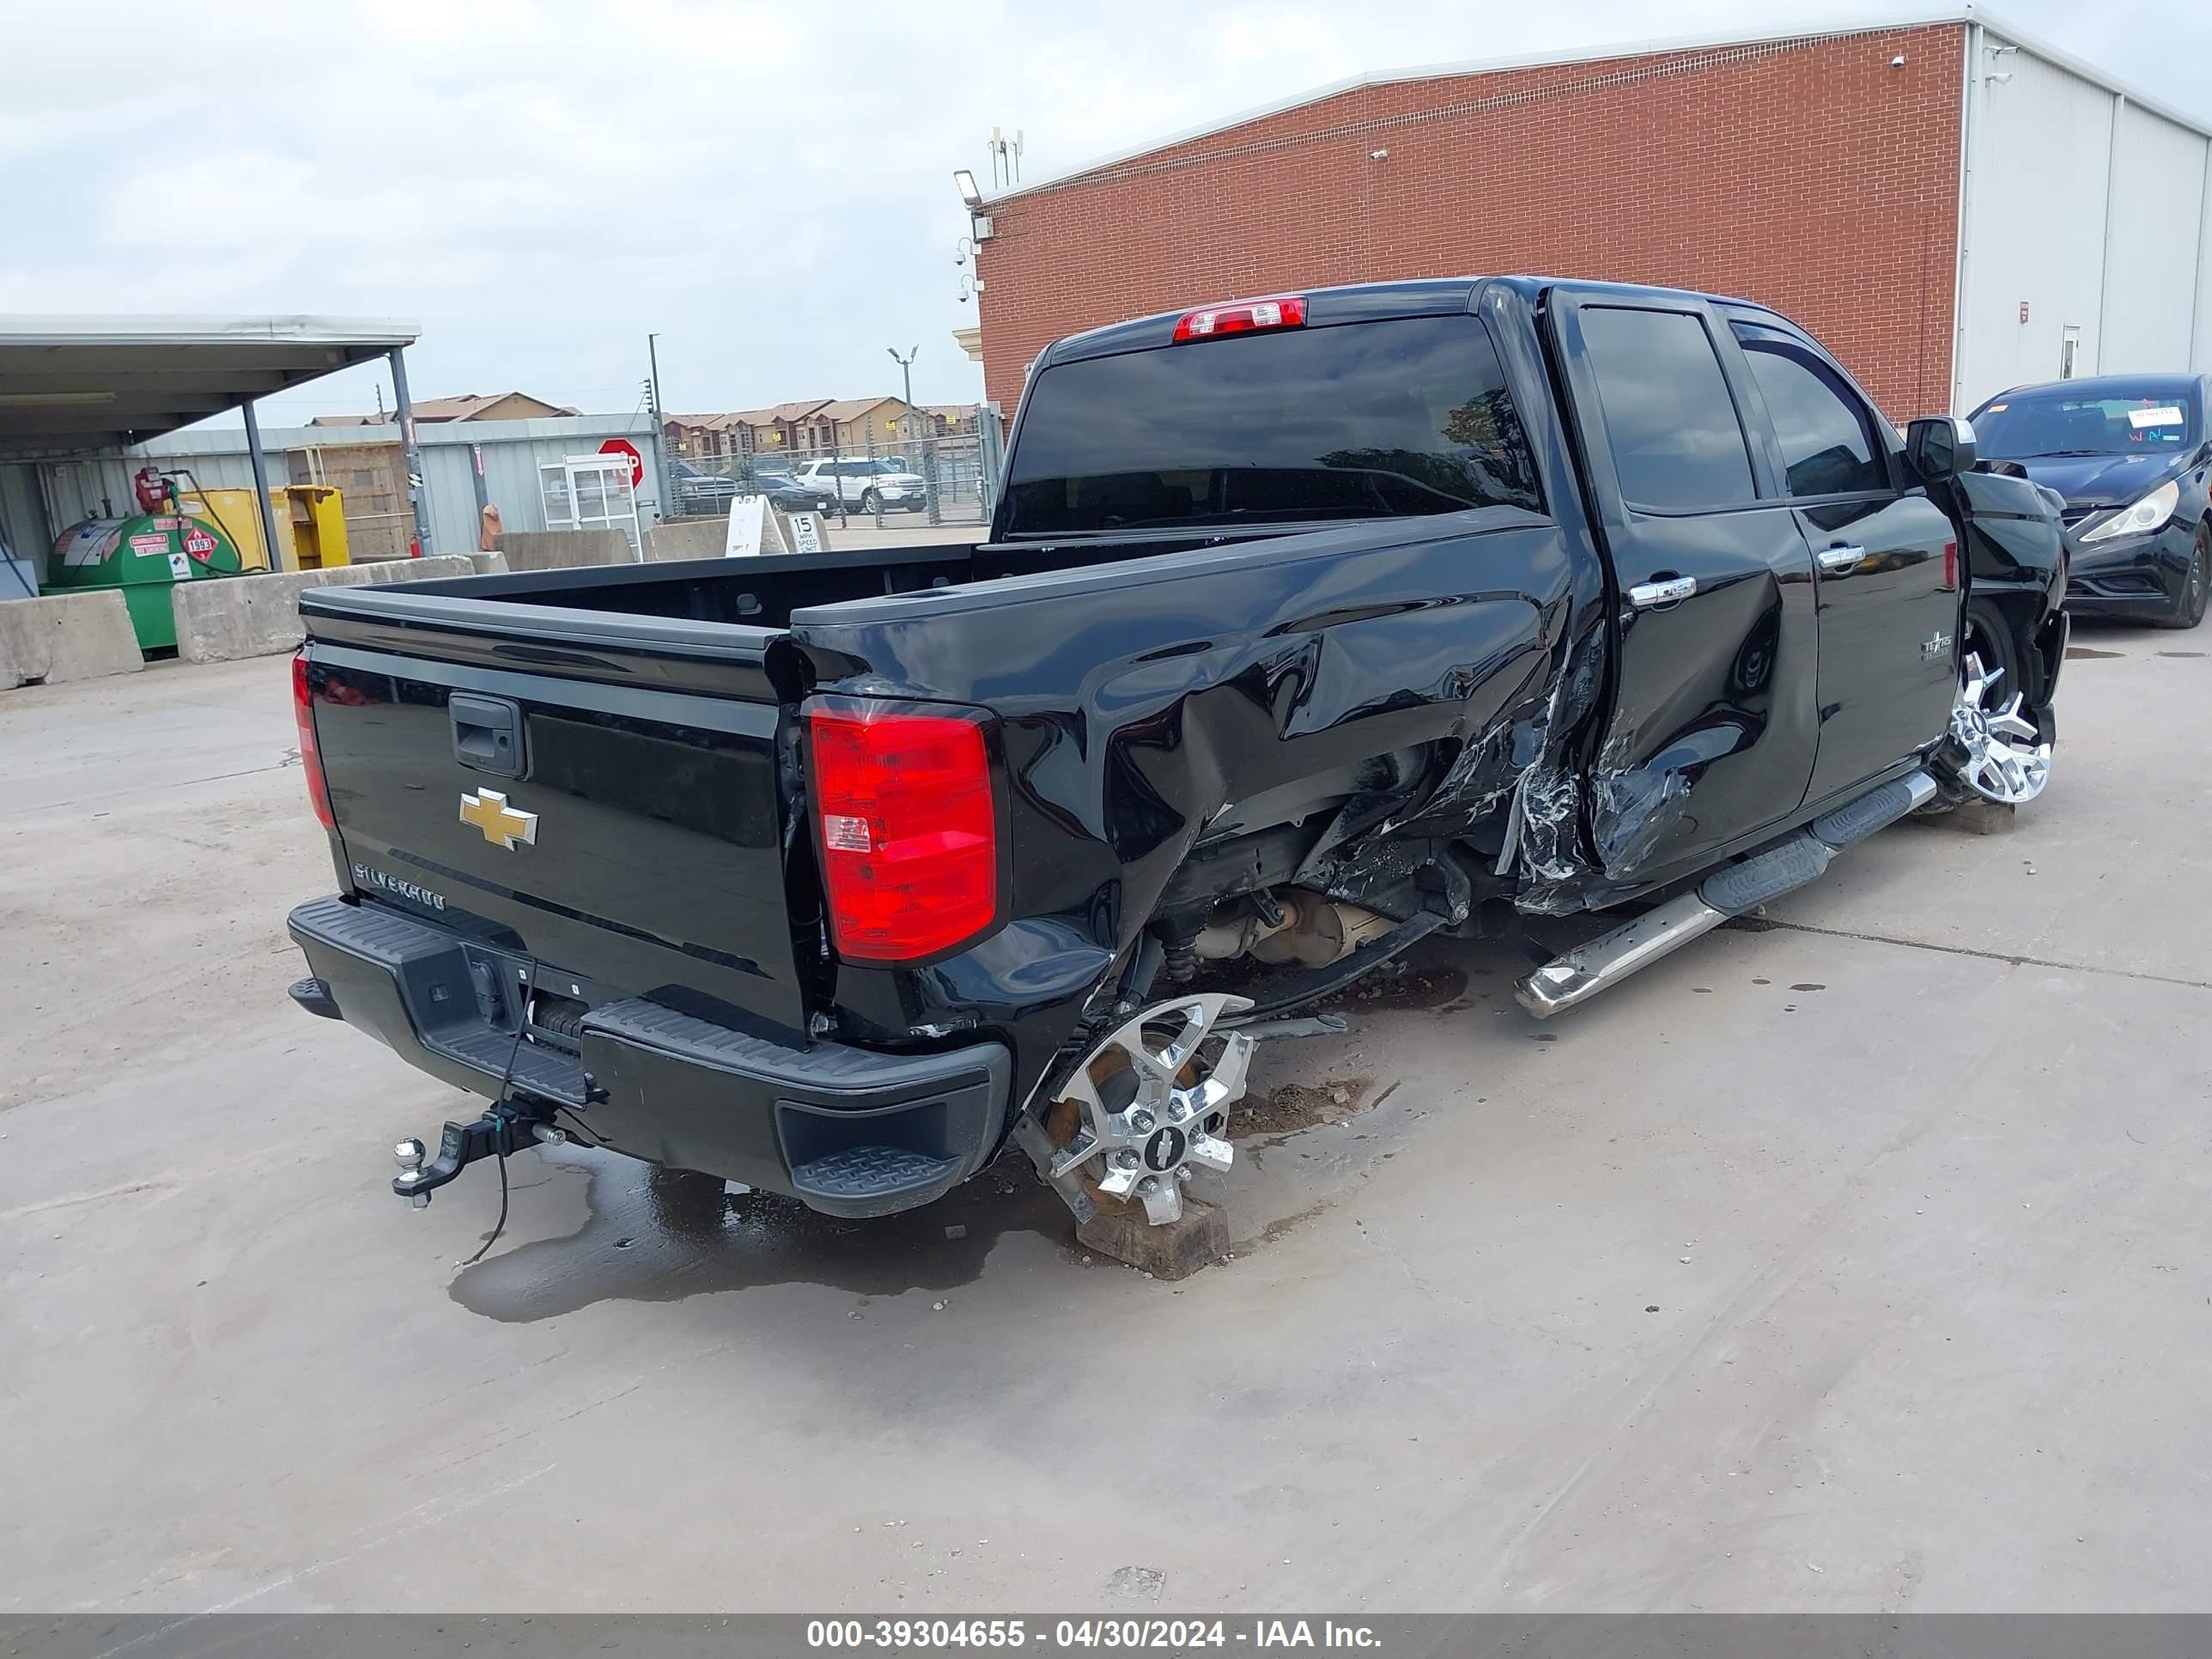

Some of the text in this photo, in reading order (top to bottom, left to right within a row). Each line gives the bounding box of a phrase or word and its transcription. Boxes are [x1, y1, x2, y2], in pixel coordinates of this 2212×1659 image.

[794, 517, 812, 533] 15
[191, 540, 210, 550] 1993
[355, 863, 447, 912] SILVERADO
